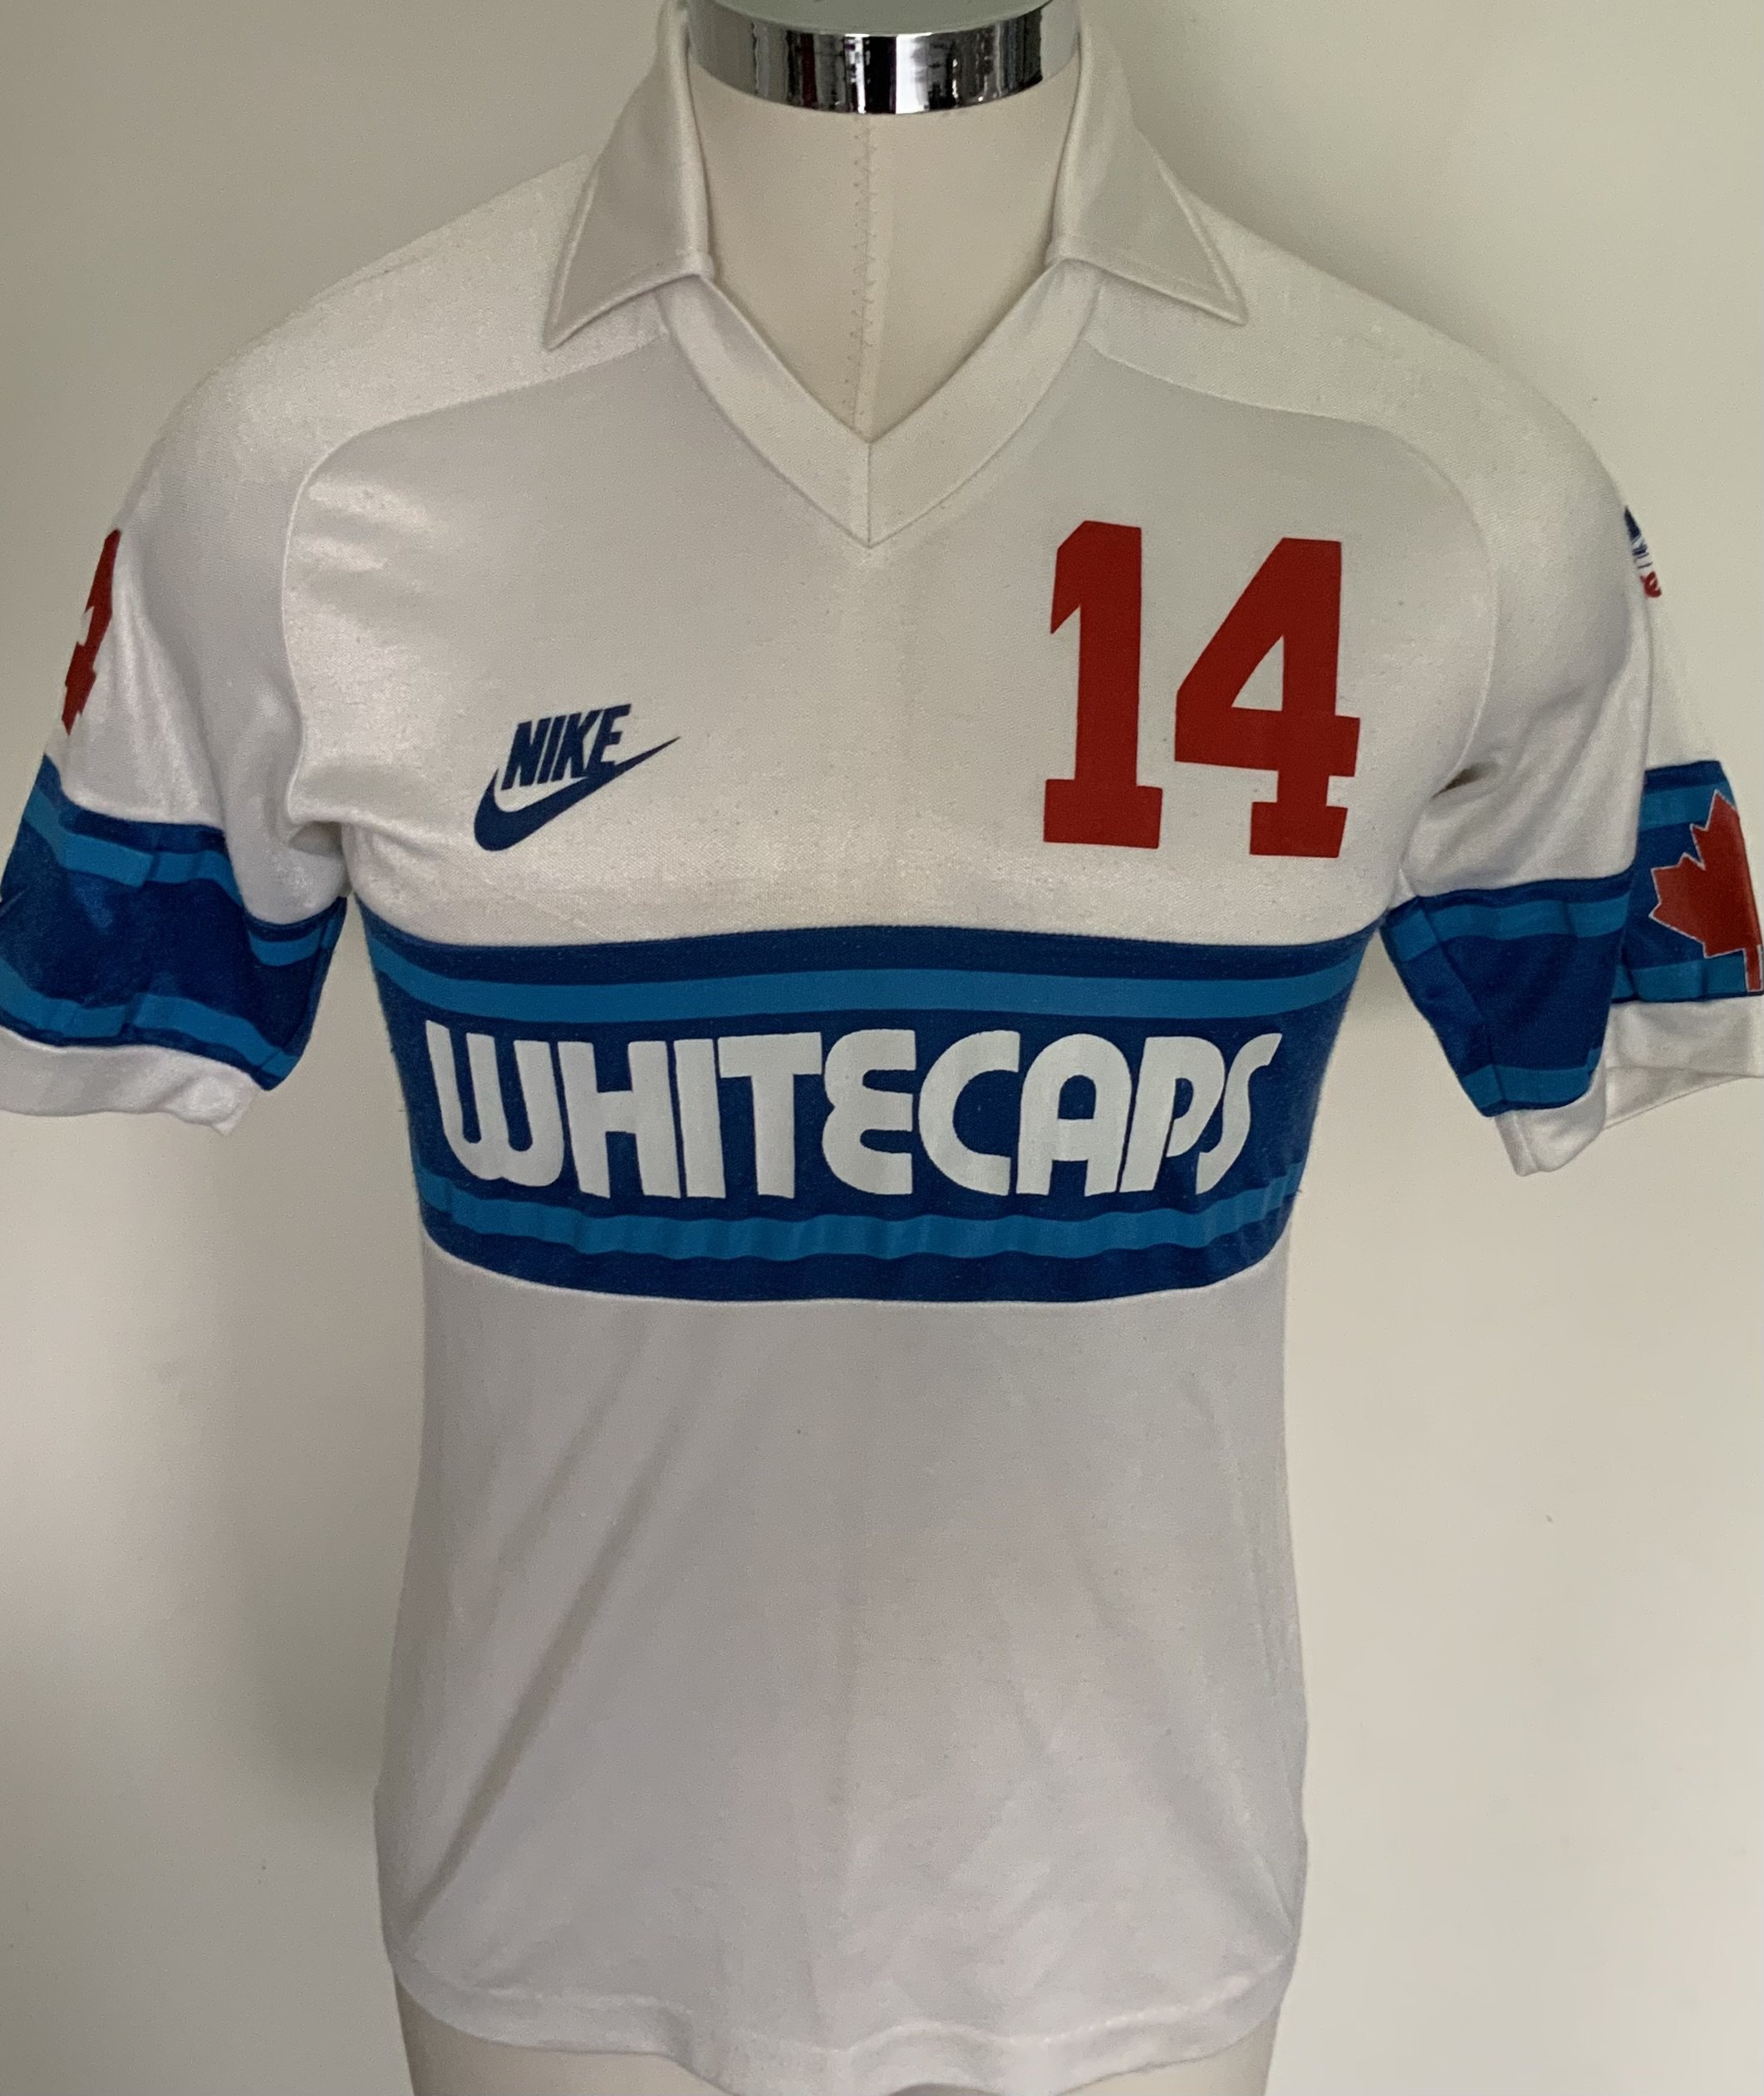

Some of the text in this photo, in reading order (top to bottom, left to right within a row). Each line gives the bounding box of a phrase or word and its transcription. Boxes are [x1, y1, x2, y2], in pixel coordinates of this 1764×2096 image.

[500, 704, 631, 790] NIKE
[1044, 521, 1360, 858] 14
[425, 1020, 1283, 1199] WHITECAPS
